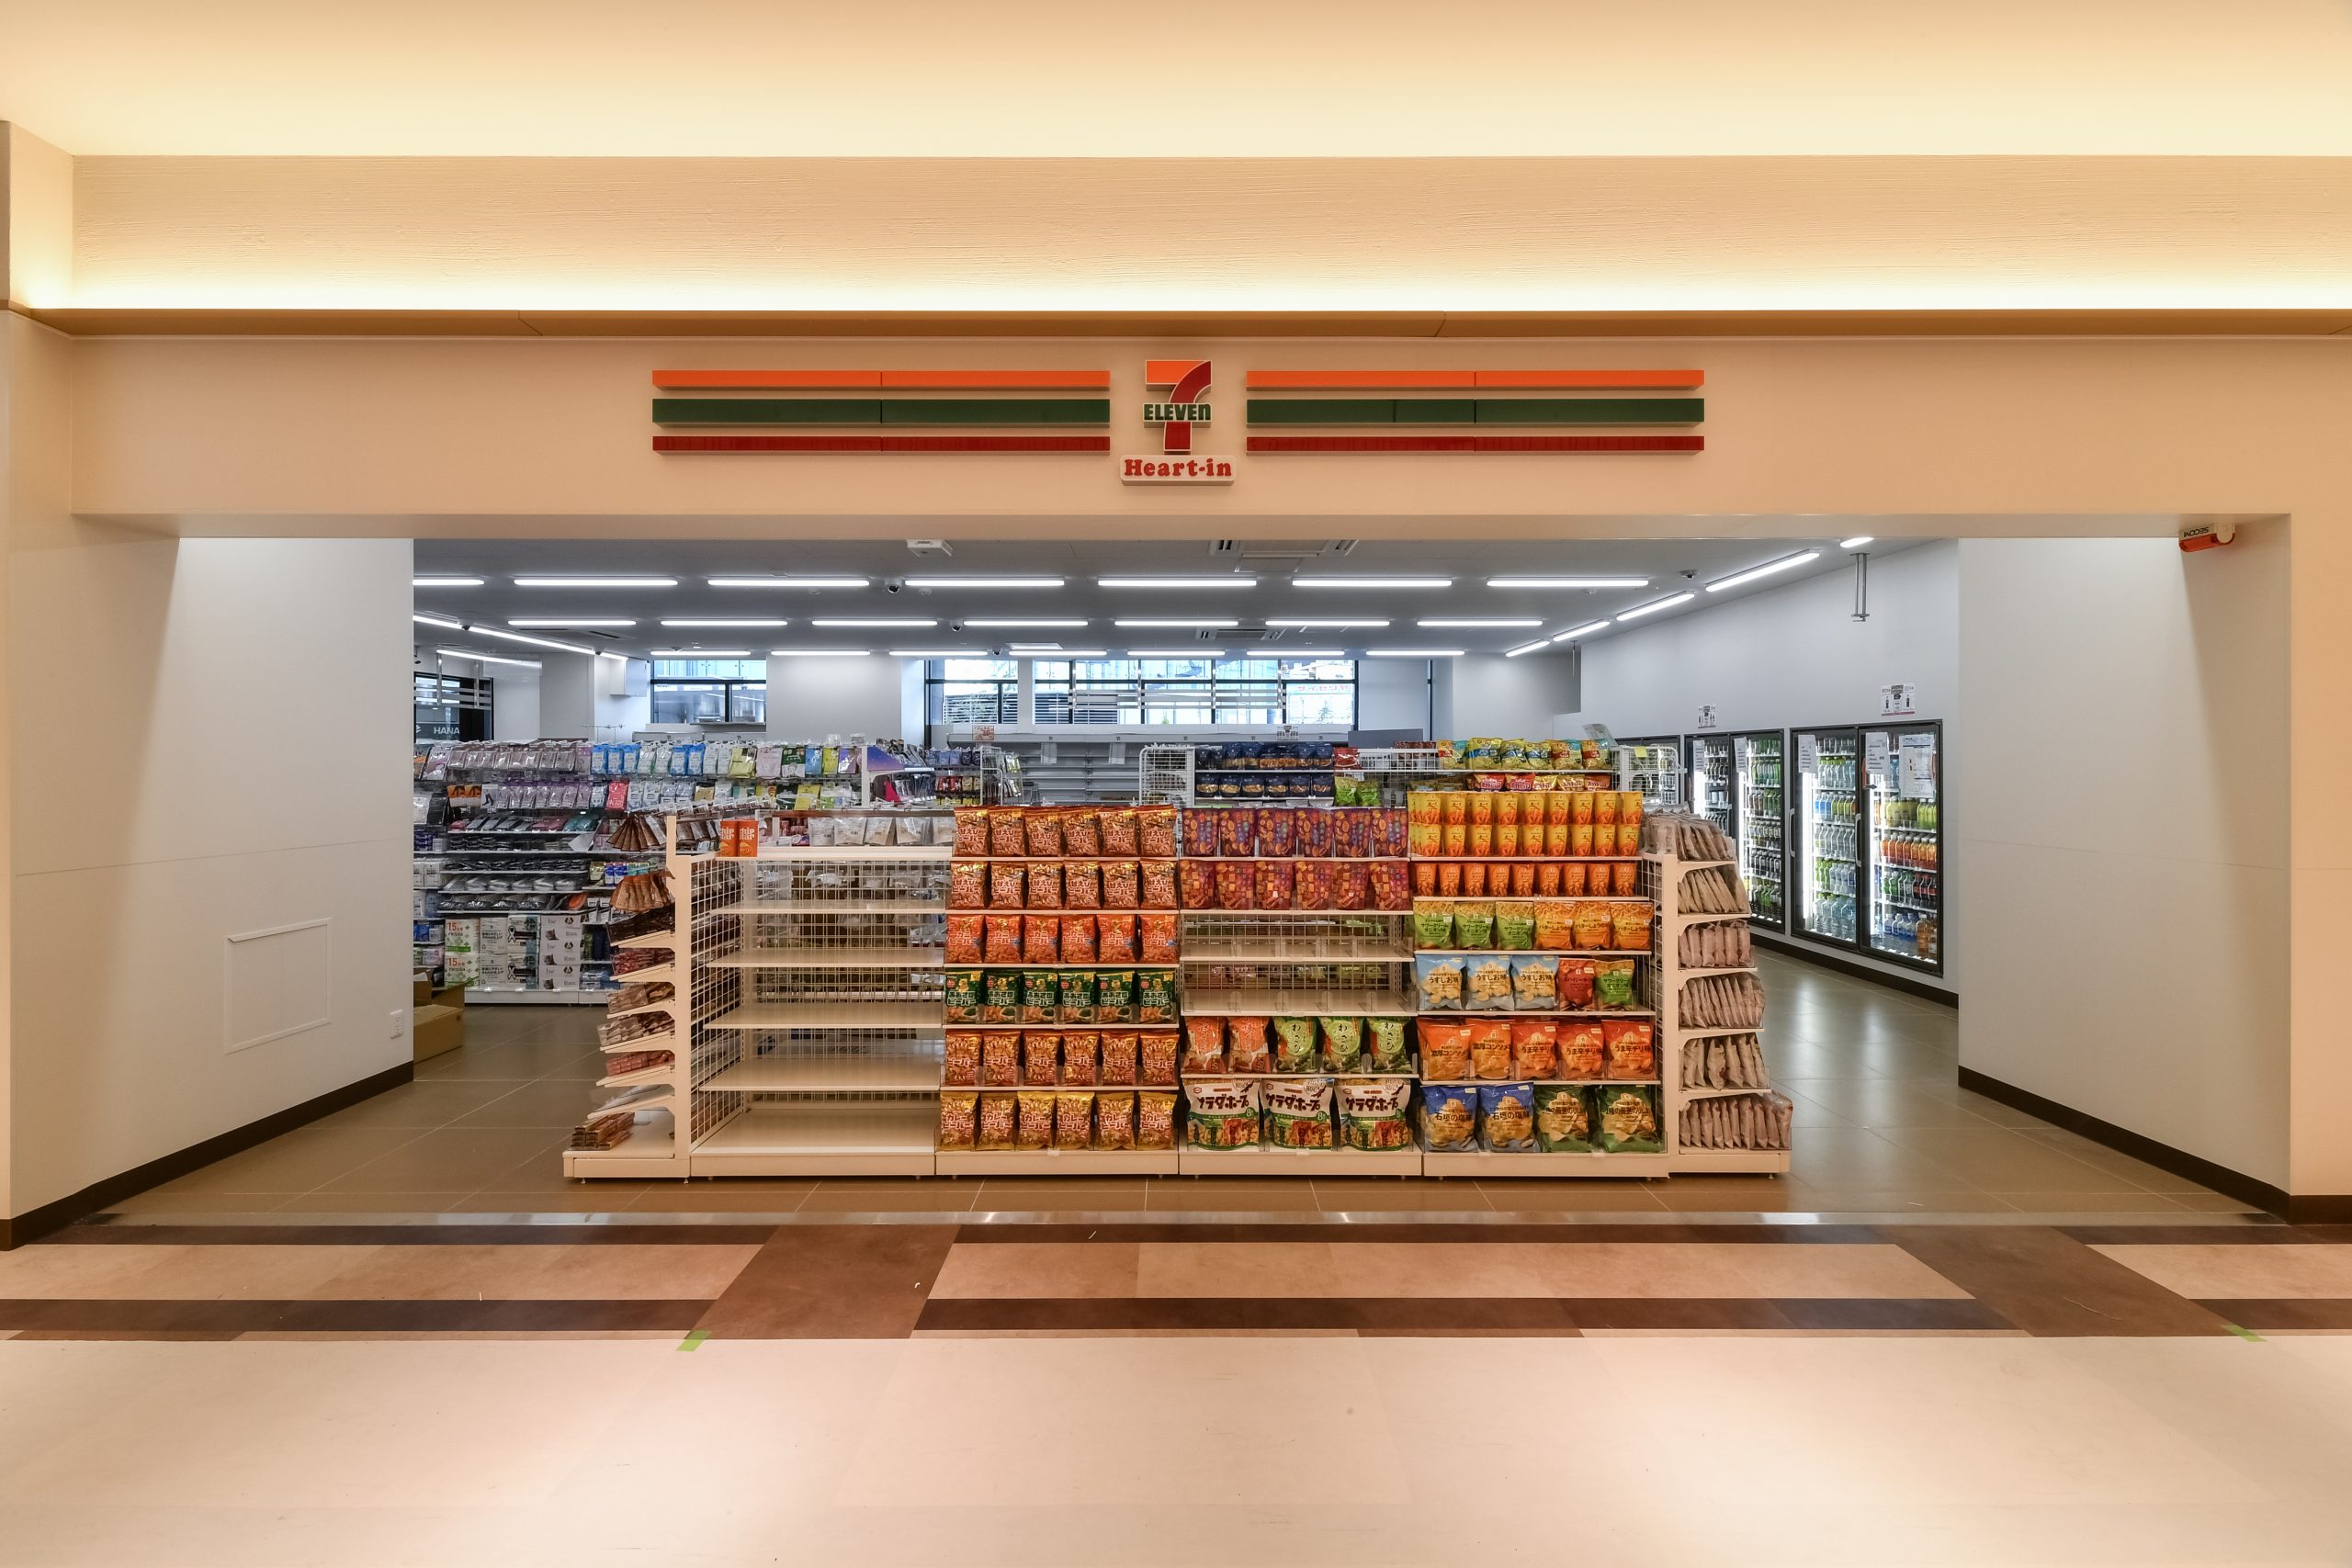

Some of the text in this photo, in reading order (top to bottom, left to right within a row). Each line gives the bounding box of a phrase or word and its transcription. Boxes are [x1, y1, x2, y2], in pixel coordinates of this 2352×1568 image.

[1146, 360, 1212, 450] 7
[1124, 458, 1232, 477] Heart-in
[2183, 526, 2210, 537] SECOM
[1265, 1093, 1321, 1111] サラダホープ
[1345, 1096, 1398, 1111] サラダホープ
[946, 1113, 967, 1122] カレー
[985, 1112, 1007, 1121] カレー
[1024, 1113, 1046, 1122] カレー
[1104, 1113, 1126, 1122] カレー
